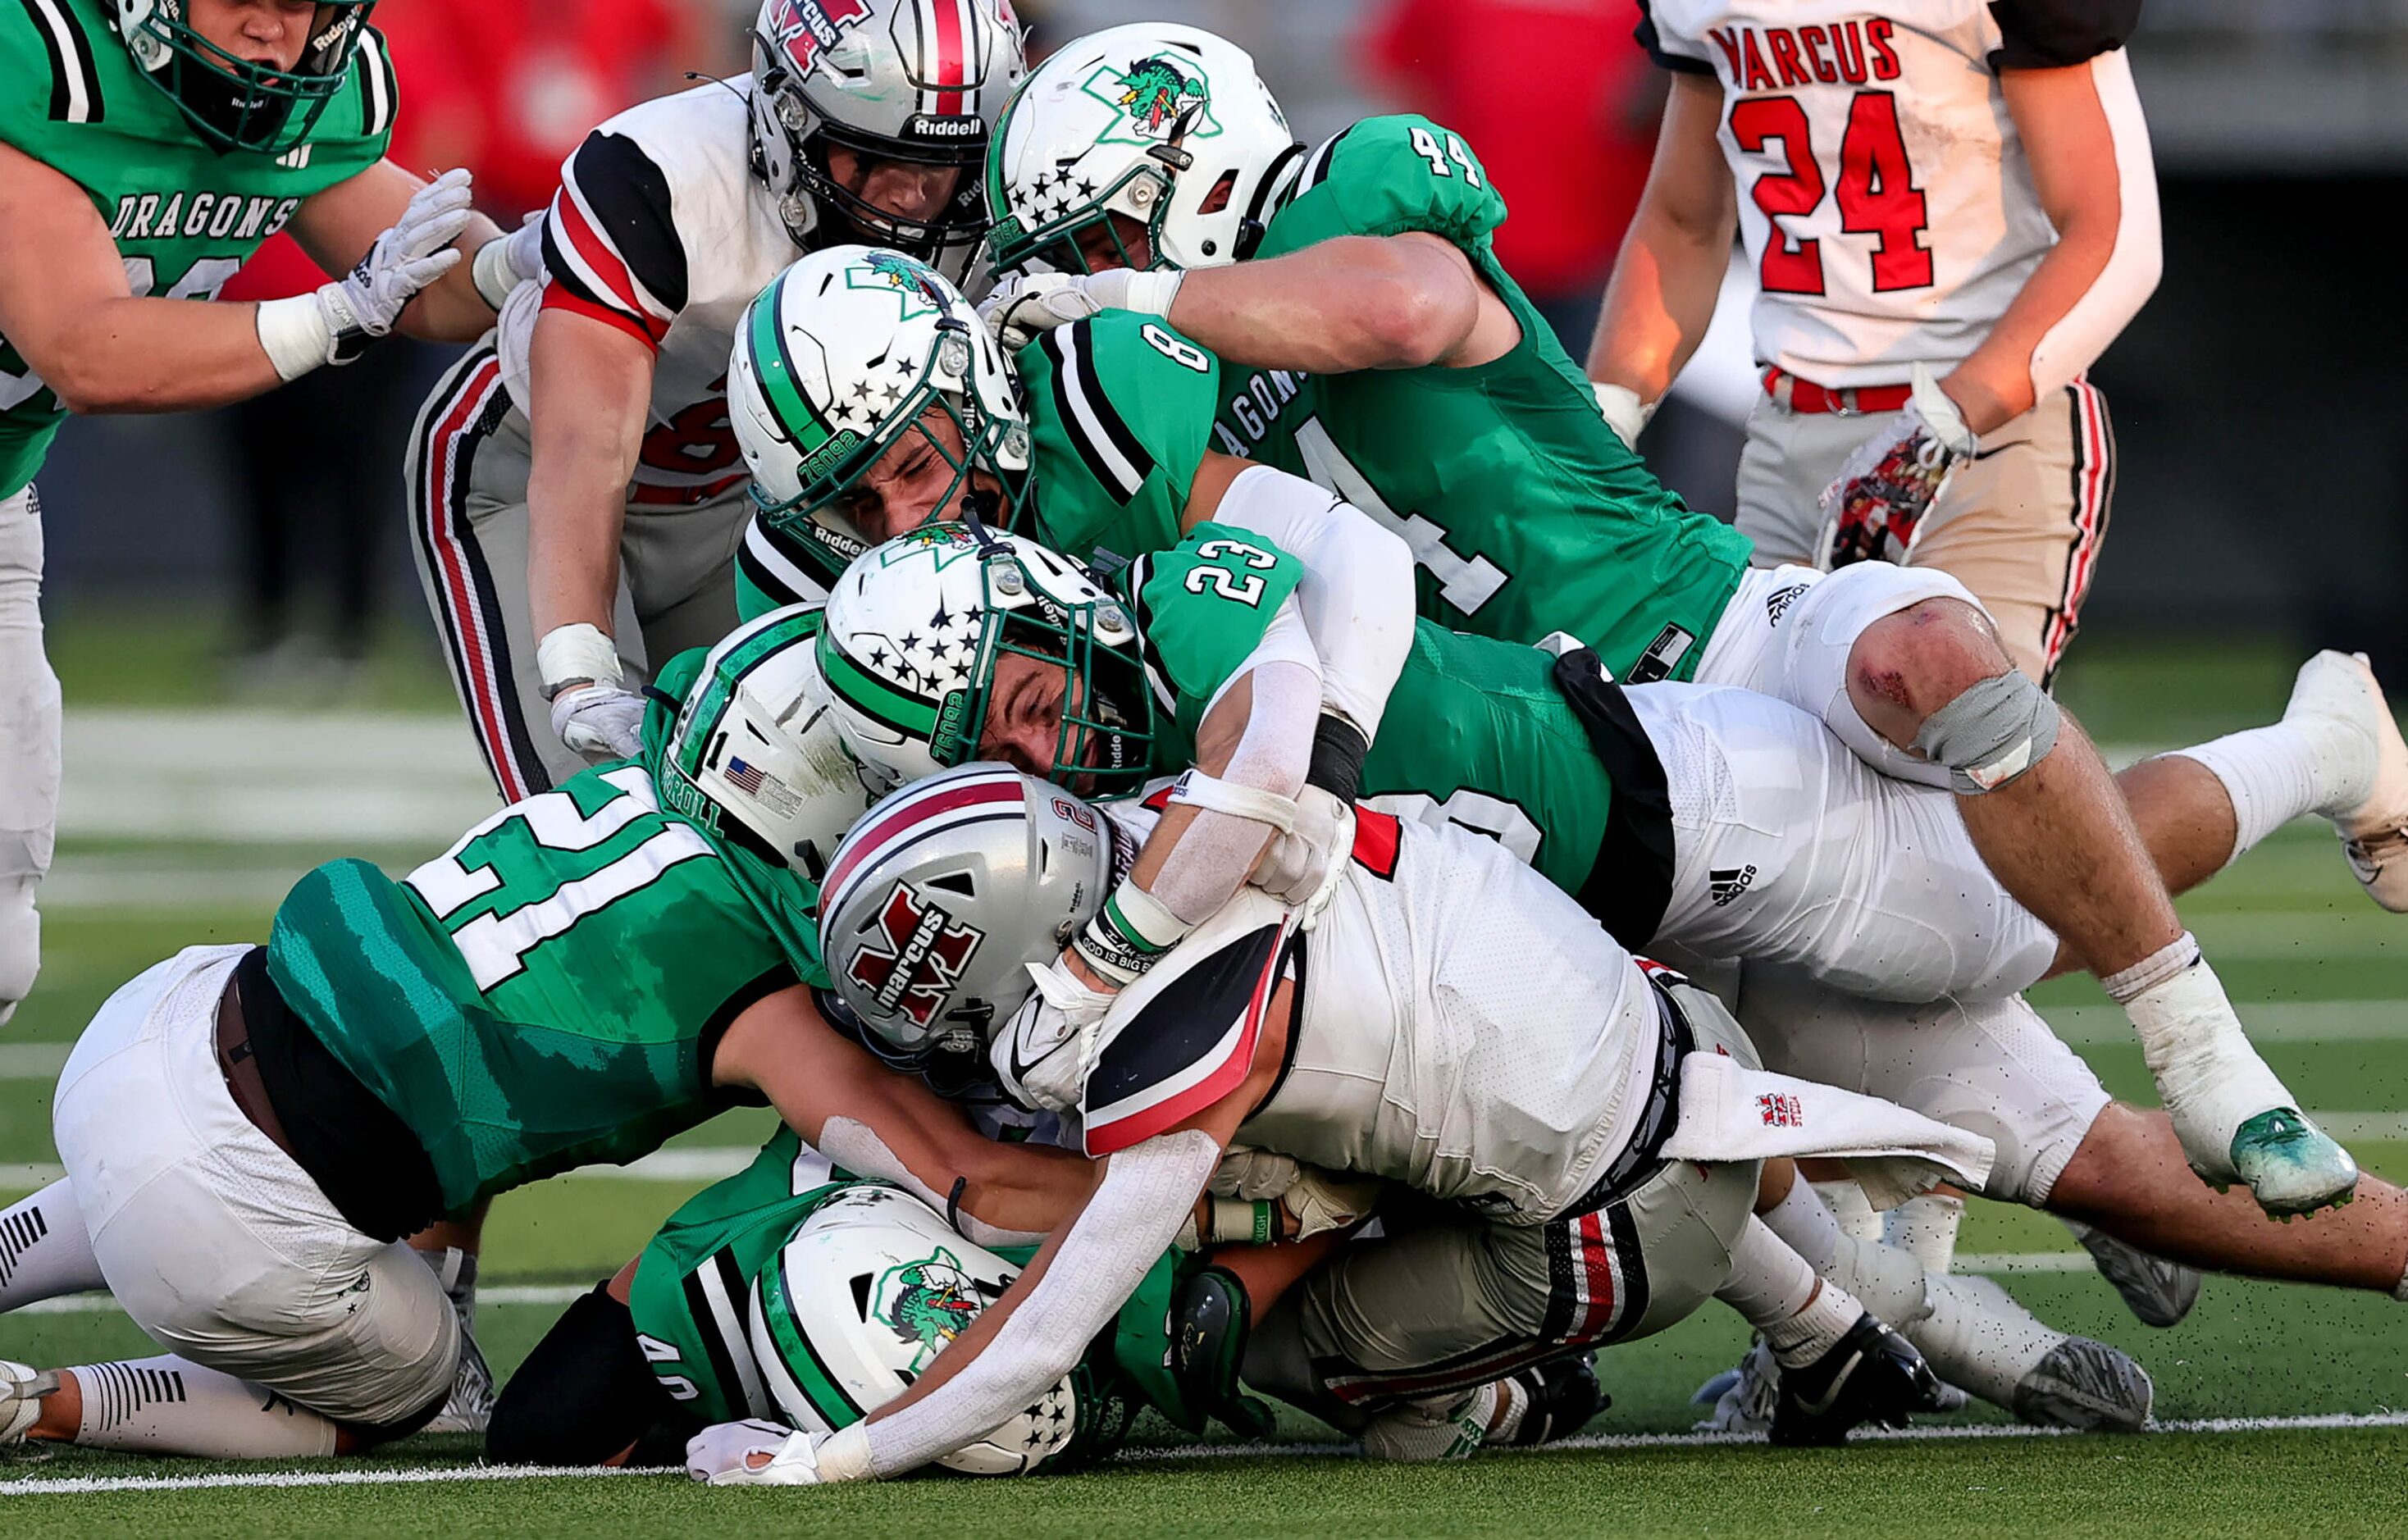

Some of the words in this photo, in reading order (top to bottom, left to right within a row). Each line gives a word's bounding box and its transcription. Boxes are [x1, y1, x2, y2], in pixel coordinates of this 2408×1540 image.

[914, 119, 981, 136] Riddell
[1407, 126, 1482, 192] 44
[111, 193, 300, 239] DRAGONS
[1730, 91, 1935, 296] 24
[1140, 322, 1210, 374] 8
[1214, 369, 1308, 458] AGON
[798, 431, 862, 485] 76092
[814, 526, 871, 558] Ridde
[1184, 540, 1278, 609] 23
[932, 692, 963, 759] 76092
[1051, 797, 1097, 836] 2
[405, 765, 719, 997] 21
[878, 909, 943, 1009] marcus
[1083, 937, 1103, 957] GOD
[1106, 952, 1117, 963] IS
[1119, 958, 1140, 971] BIG
[1256, 1214, 1267, 1242] OUGH
